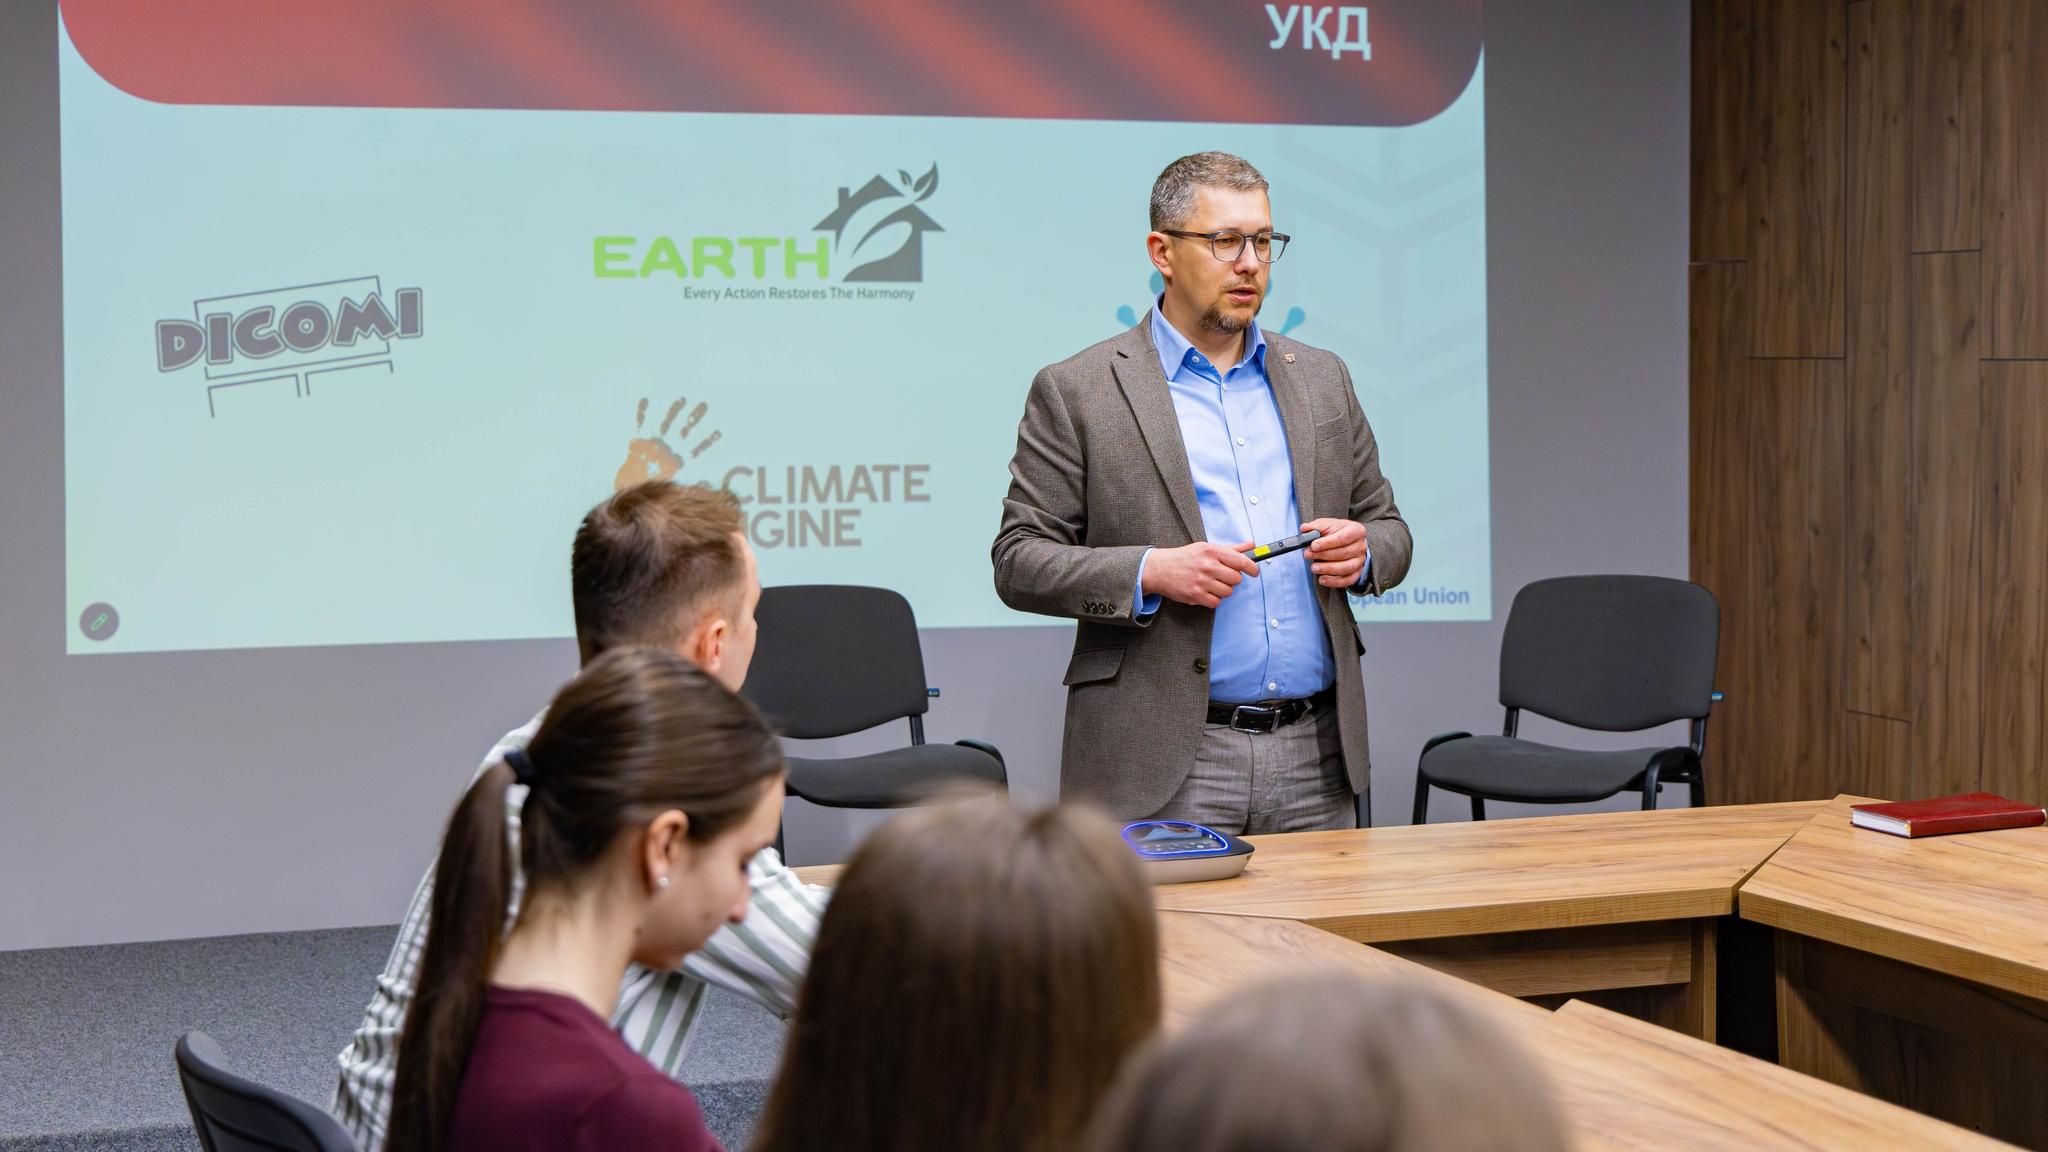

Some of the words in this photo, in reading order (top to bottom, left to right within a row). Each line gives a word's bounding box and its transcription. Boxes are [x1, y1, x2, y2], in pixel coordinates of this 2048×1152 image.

[1264, 4, 1371, 60] УКД
[593, 236, 829, 279] EARTH
[684, 286, 720, 302] Every
[724, 287, 766, 299] Action
[769, 287, 826, 299] Restores
[830, 287, 853, 299] The
[857, 287, 915, 302] Harmony
[156, 287, 422, 372] DICOMI
[722, 464, 930, 504] CLIMATE
[741, 509, 861, 548] GINE
[1349, 591, 1407, 608] opean
[1414, 587, 1469, 604] Union
